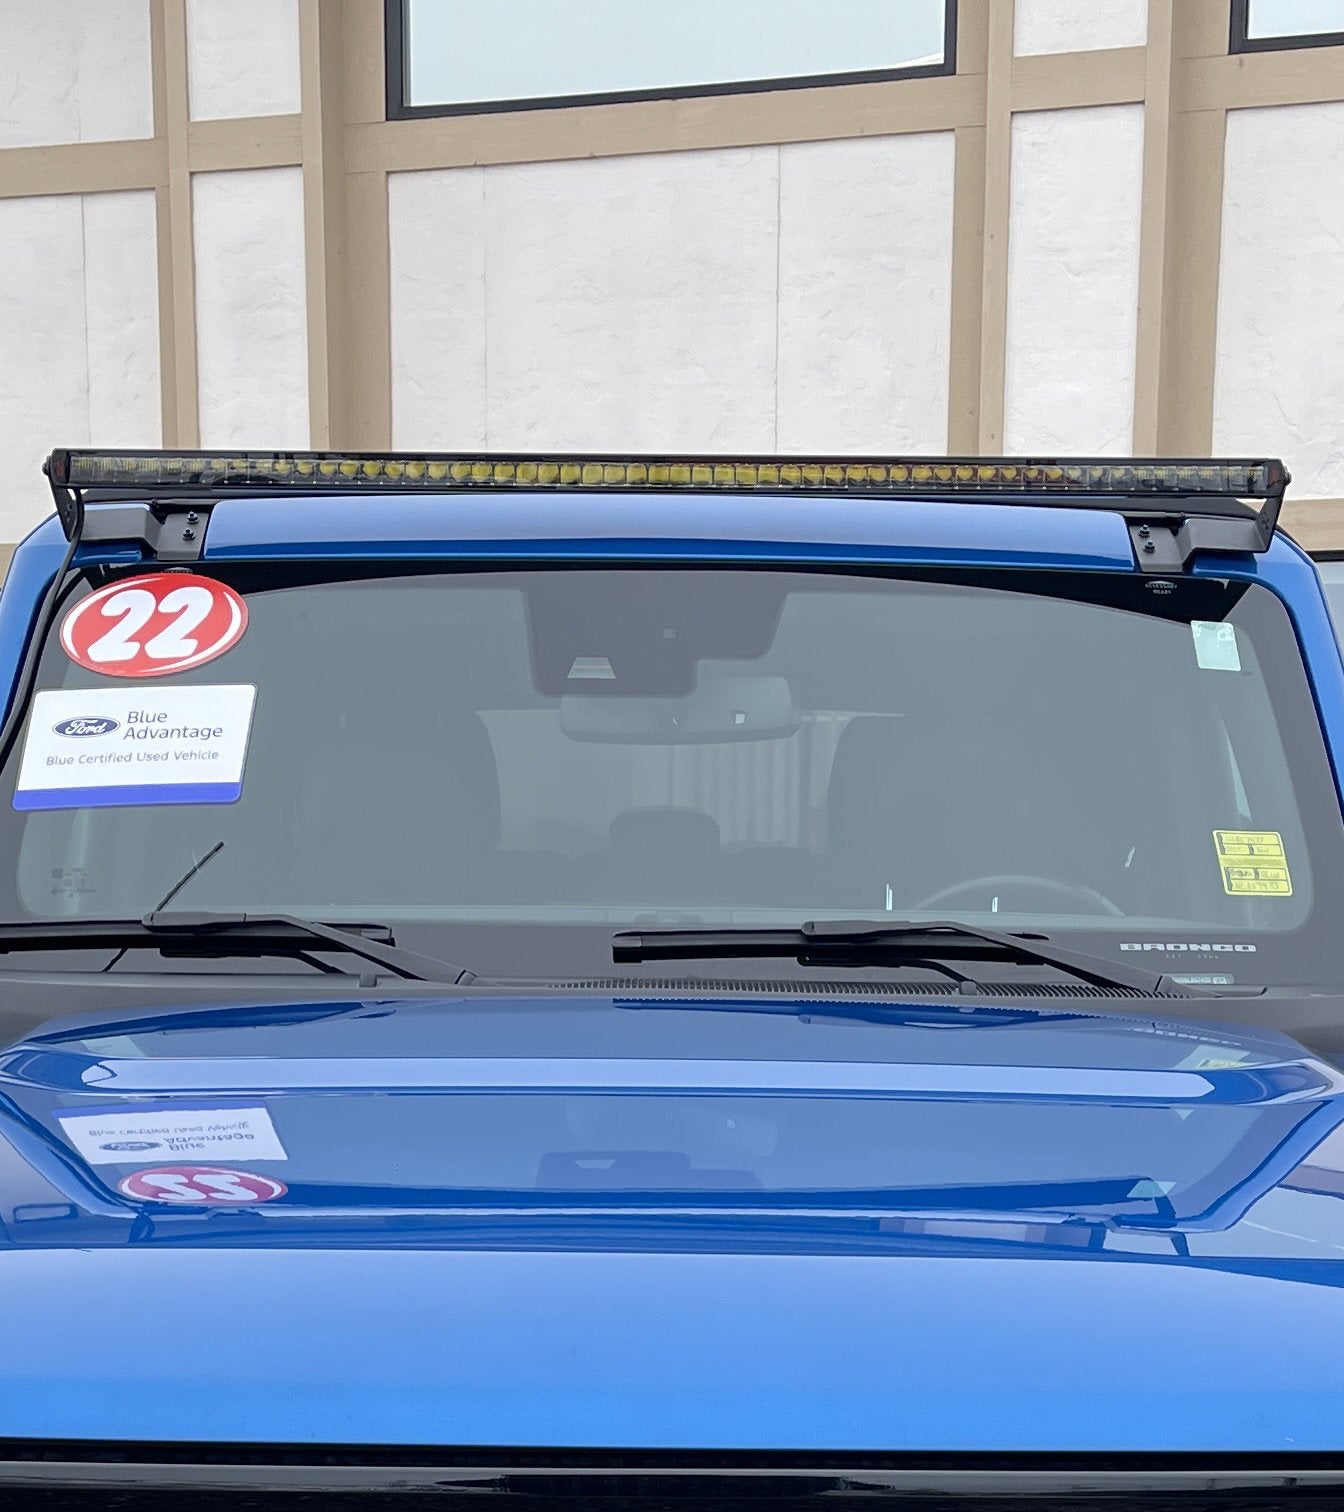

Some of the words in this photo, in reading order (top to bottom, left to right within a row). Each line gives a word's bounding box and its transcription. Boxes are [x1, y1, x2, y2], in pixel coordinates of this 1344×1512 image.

[86, 585, 214, 663] 22
[127, 709, 168, 724] Blue
[122, 725, 224, 741] Advantage
[46, 755, 75, 767] Blue
[78, 751, 133, 765] Certified
[136, 750, 170, 762] Used
[174, 748, 220, 761] Vehicle
[1119, 943, 1257, 952] BRONCO
